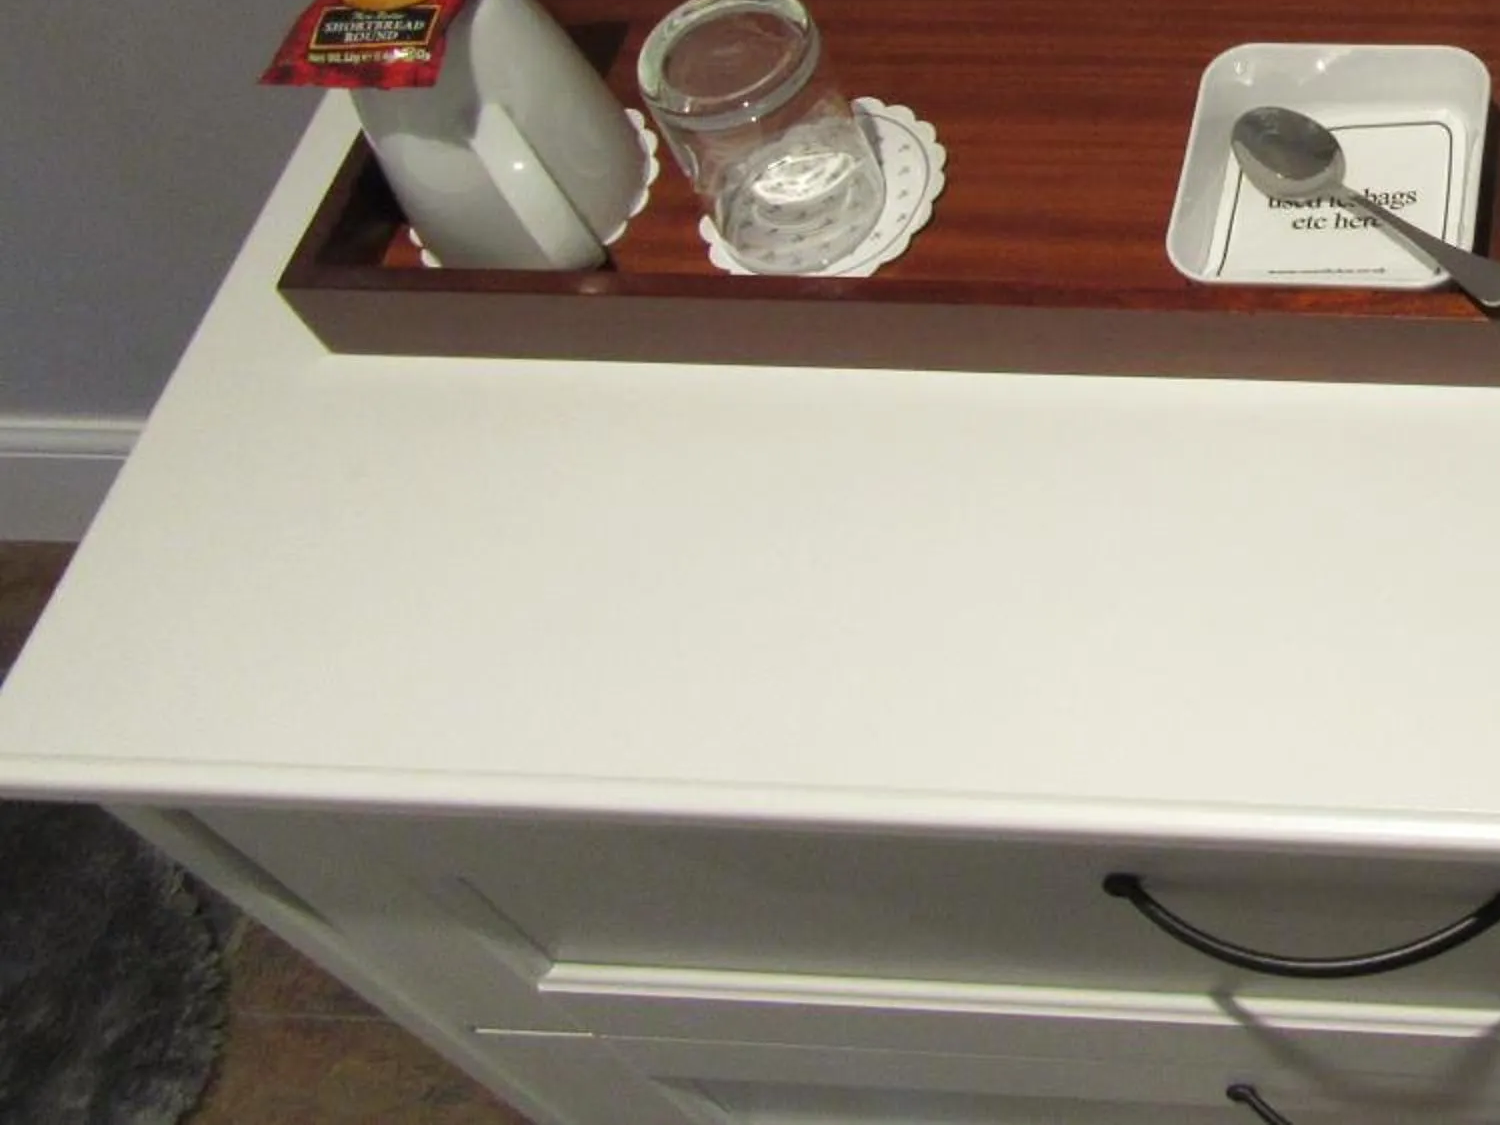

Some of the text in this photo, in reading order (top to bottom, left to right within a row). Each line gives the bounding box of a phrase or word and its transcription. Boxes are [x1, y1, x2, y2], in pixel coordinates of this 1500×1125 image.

[324, 20, 425, 33] SHORTBREAD
[344, 30, 399, 43] ROUND
[1364, 188, 1417, 210] bags
[1292, 215, 1328, 230] etc
